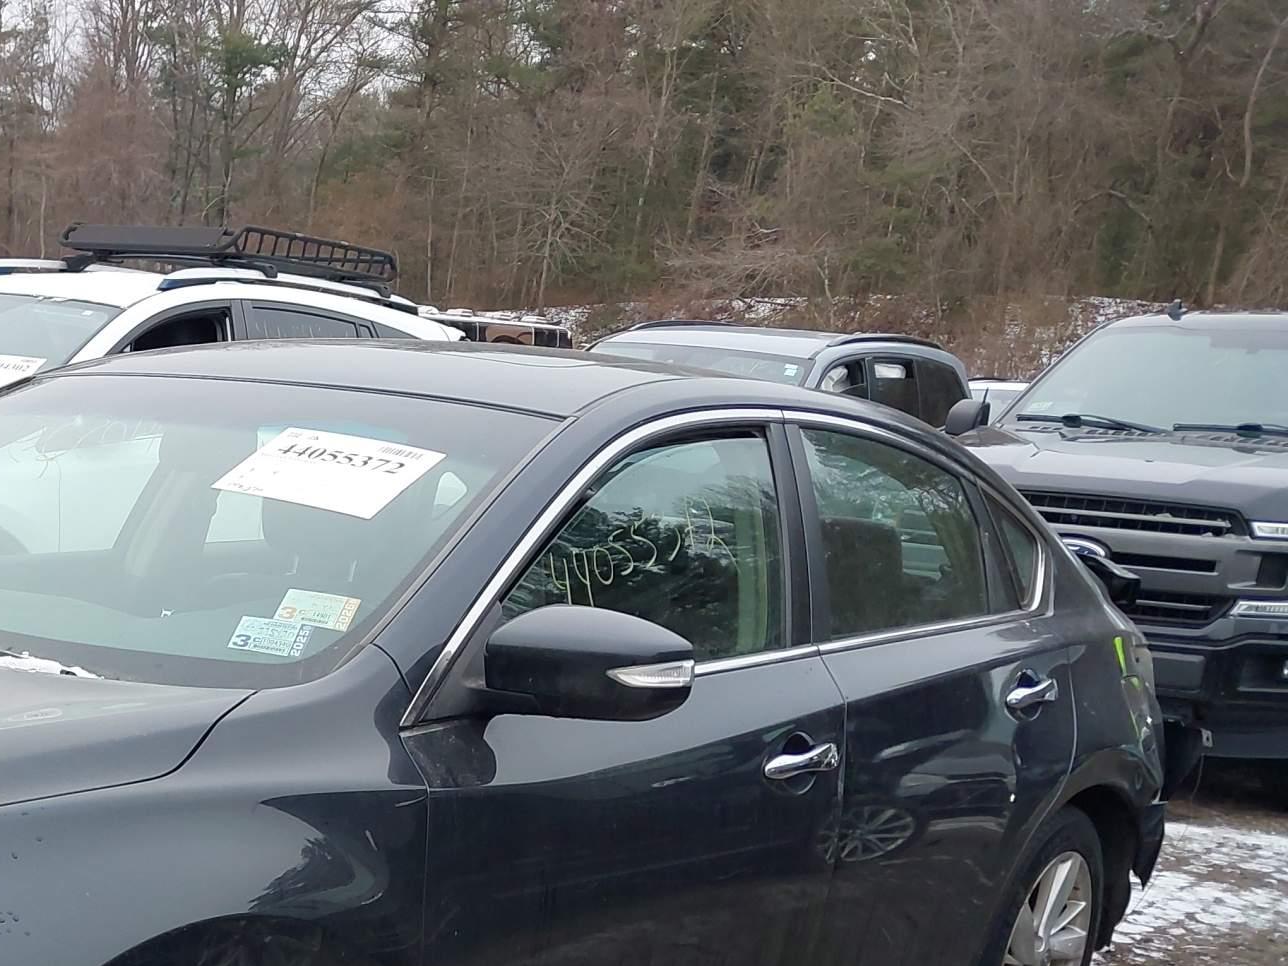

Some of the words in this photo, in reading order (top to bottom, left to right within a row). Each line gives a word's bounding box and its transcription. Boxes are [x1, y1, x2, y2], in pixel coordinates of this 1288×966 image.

[277, 442, 406, 475] 44055372
[278, 606, 297, 620] 3
[232, 634, 252, 648] 3
[290, 628, 310, 657] 2025
